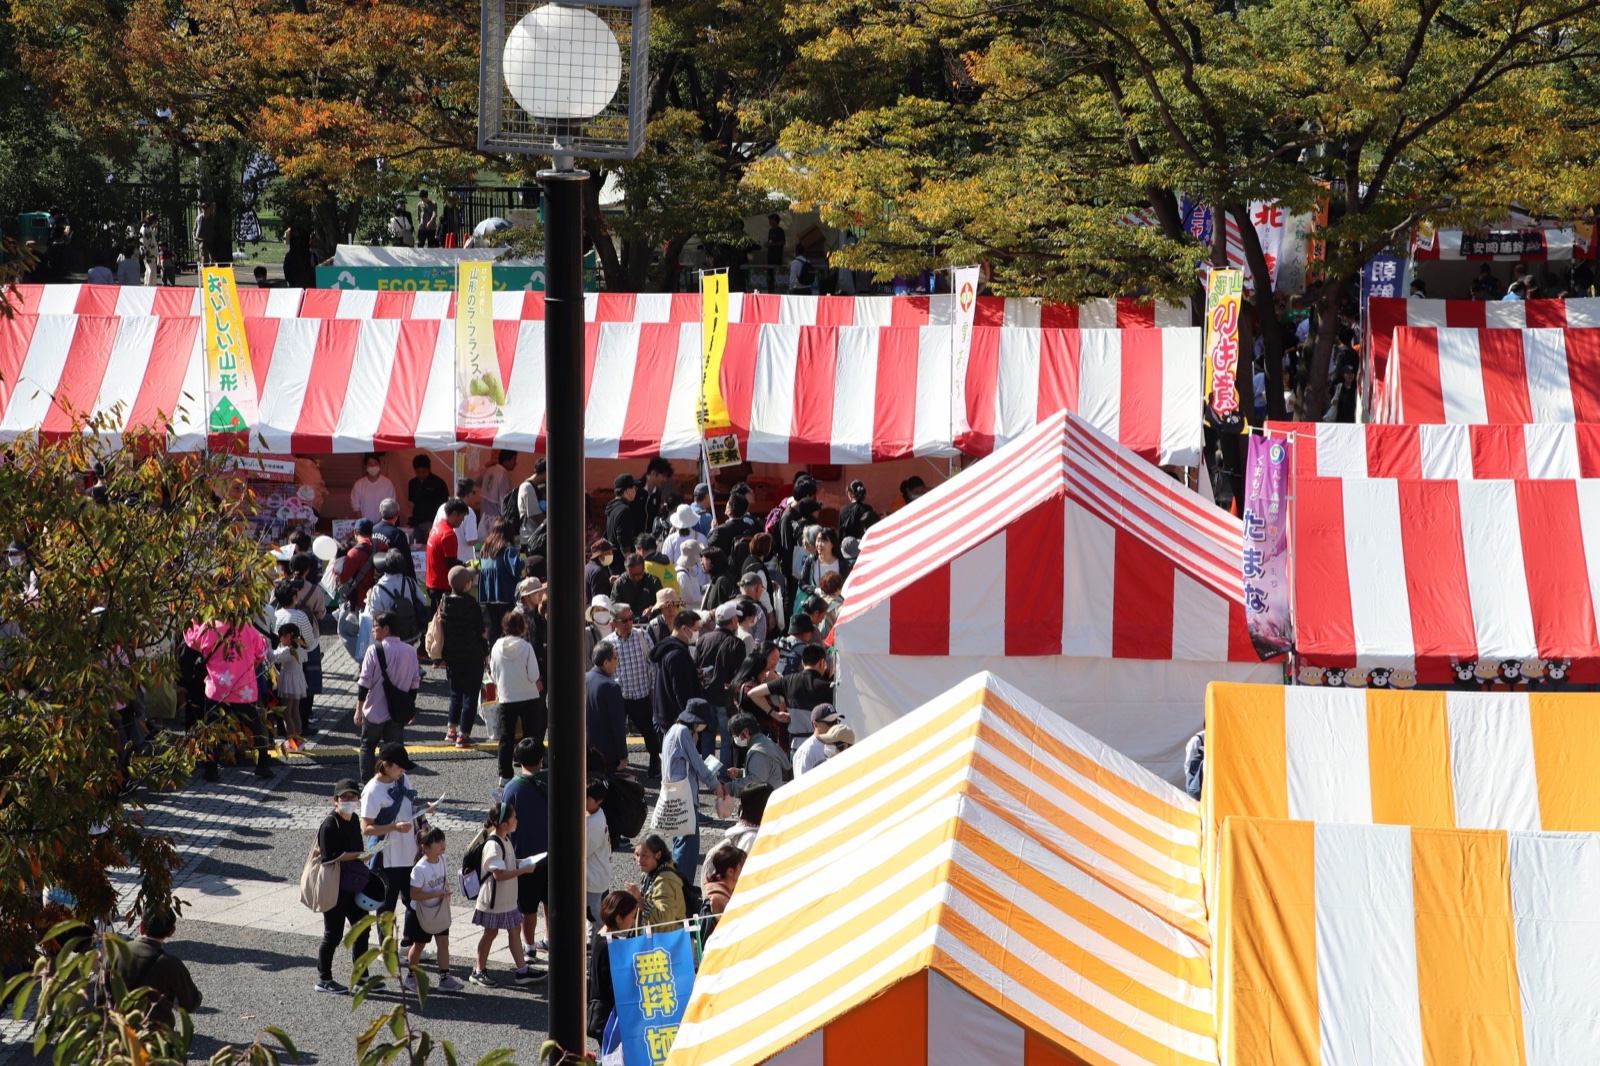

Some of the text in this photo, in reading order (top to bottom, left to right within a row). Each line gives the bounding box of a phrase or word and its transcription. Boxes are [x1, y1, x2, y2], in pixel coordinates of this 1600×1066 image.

[207, 273, 239, 391] おいしい山形
[467, 267, 482, 375] 山形のラ・フランス
[709, 449, 738, 464] 芋煮
[1243, 455, 1269, 614] くまもと たまな
